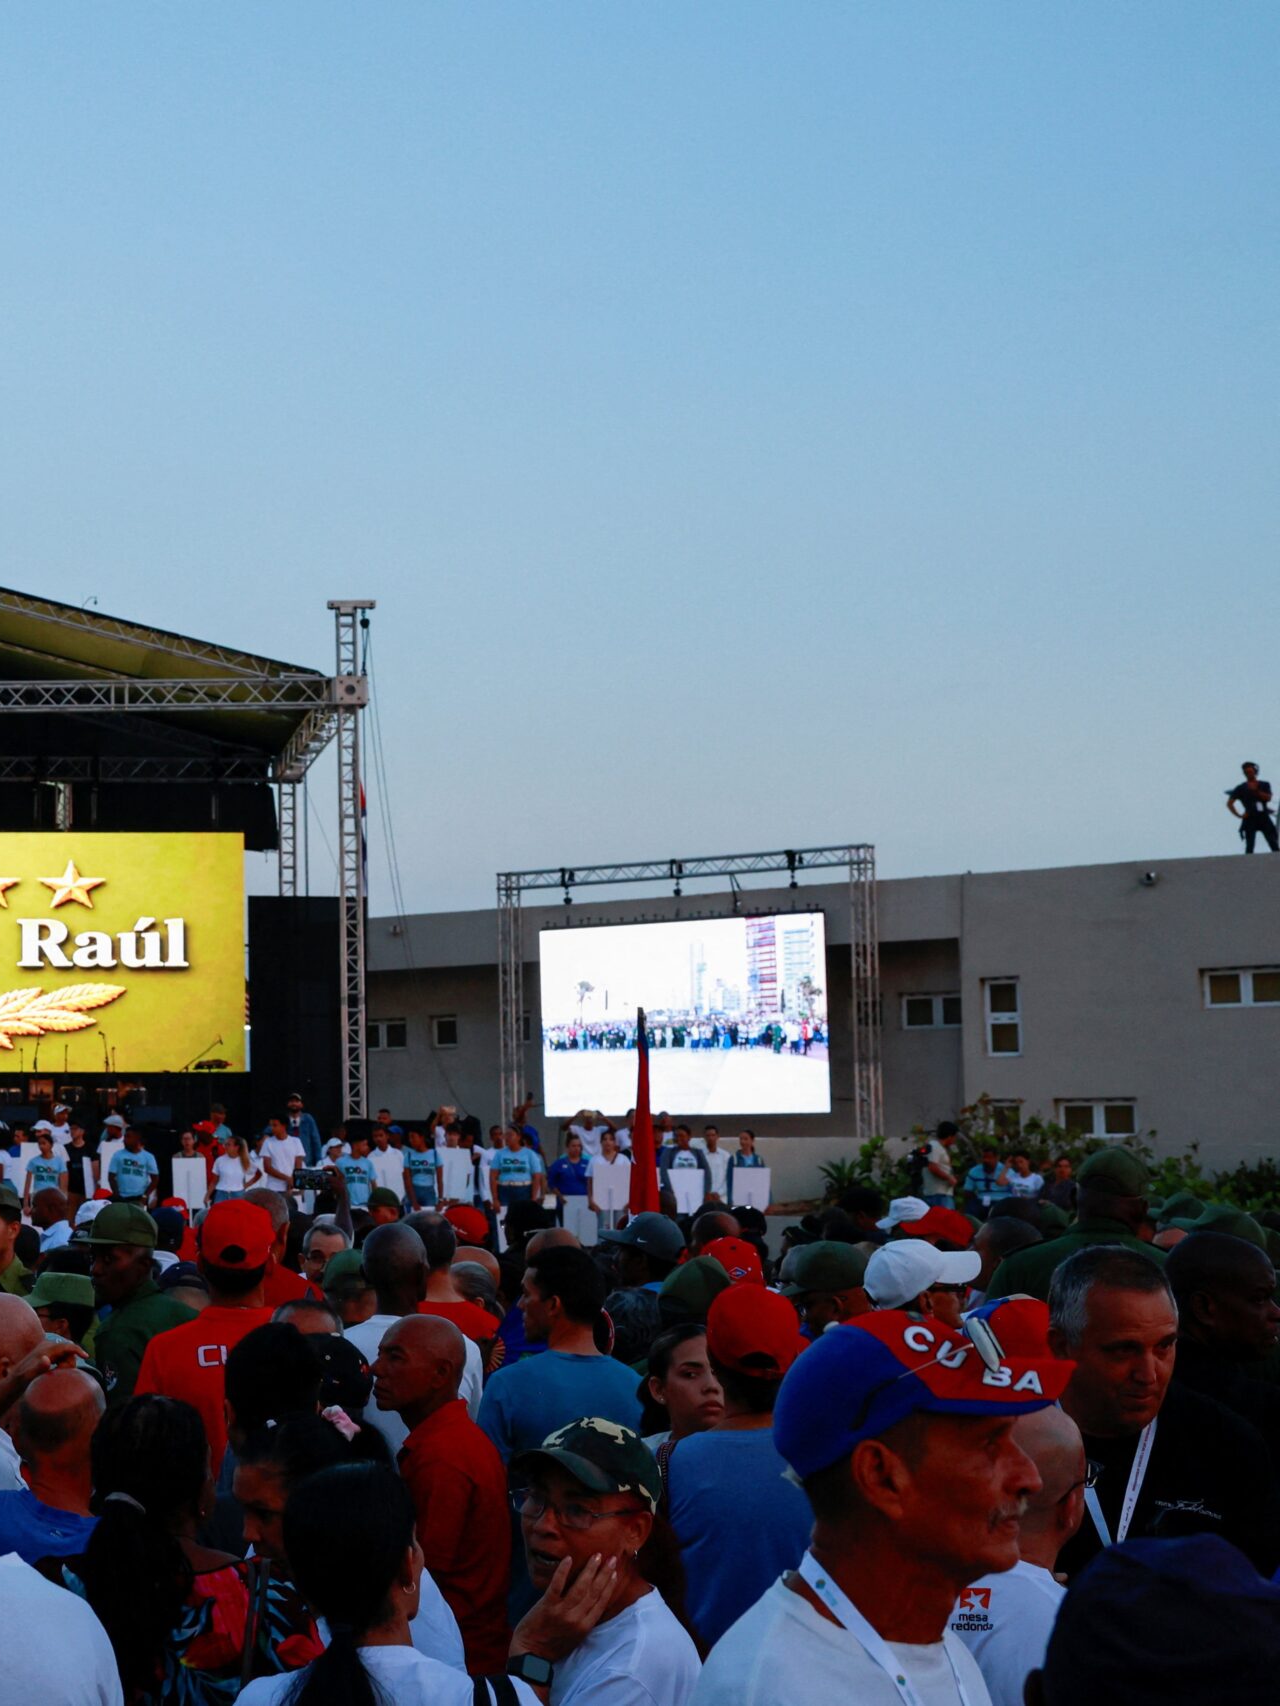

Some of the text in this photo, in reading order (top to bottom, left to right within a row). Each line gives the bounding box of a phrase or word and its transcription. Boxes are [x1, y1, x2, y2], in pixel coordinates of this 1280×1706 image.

[16, 916, 190, 968] Raúl
[903, 1325, 1044, 1395] CUBA
[959, 1613, 988, 1622] mesa
